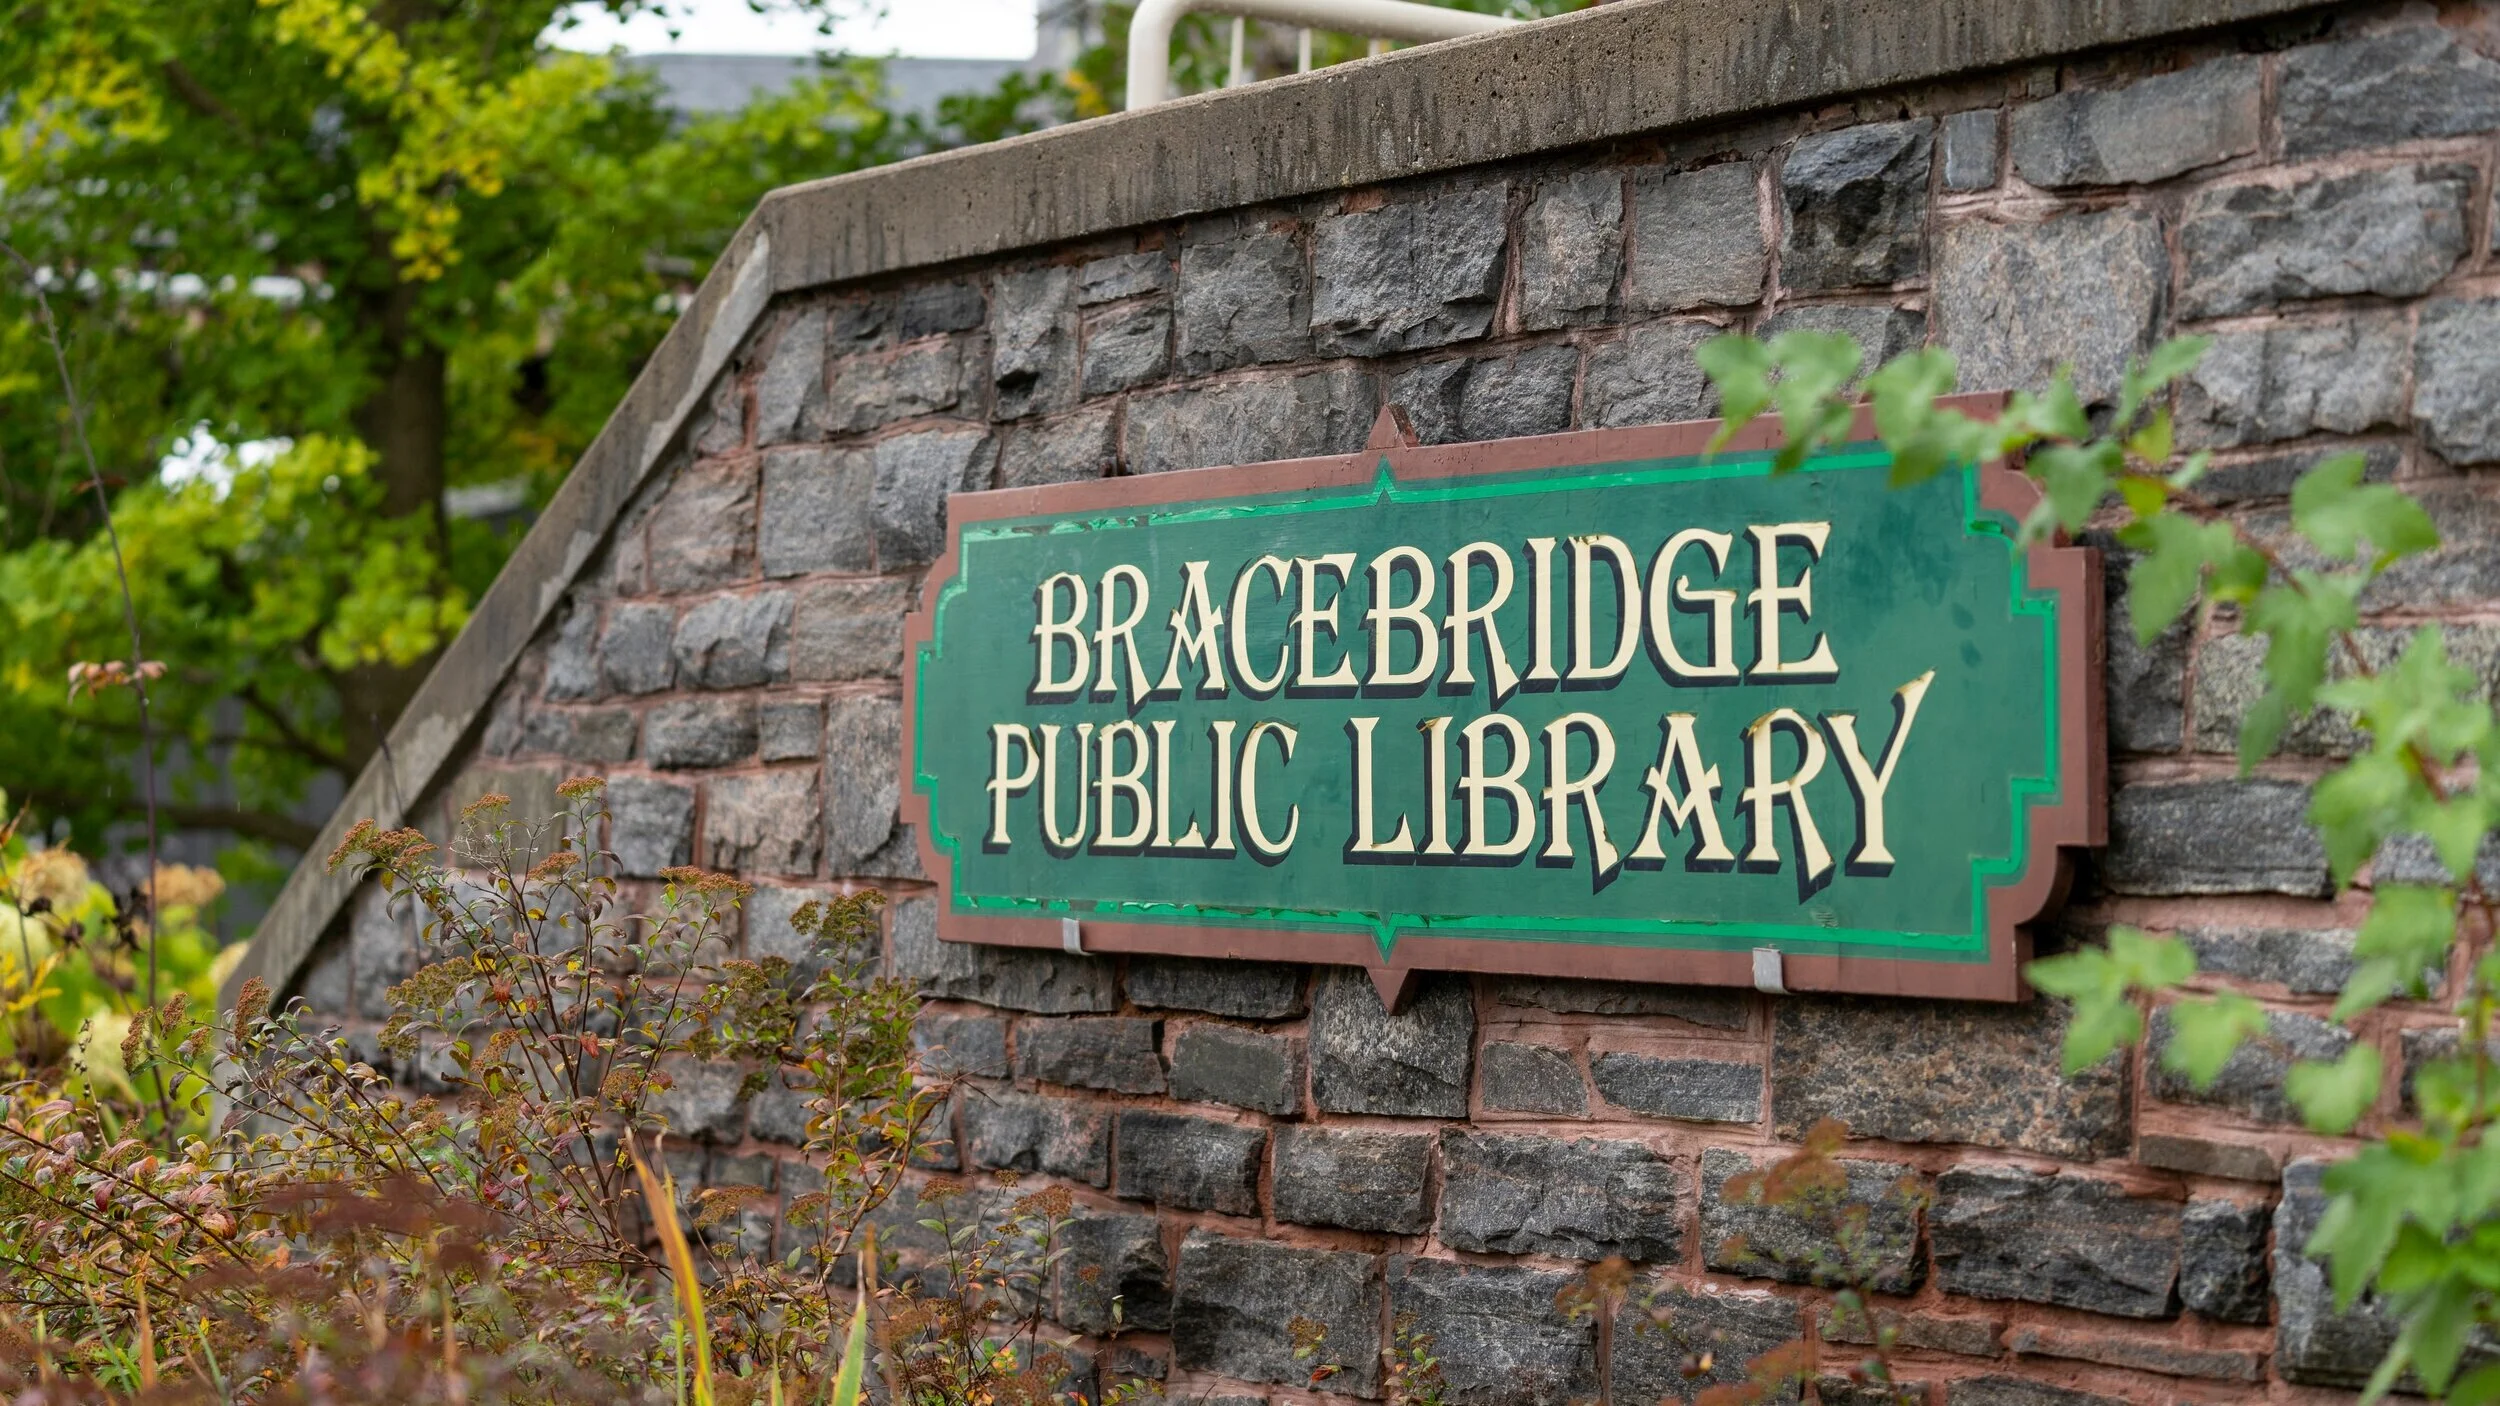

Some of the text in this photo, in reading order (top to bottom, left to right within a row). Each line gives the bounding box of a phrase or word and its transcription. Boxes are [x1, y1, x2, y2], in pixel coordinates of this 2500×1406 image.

[1029, 521, 1840, 707] BRACEBRIDGE
[985, 670, 1936, 886] PUBLIC LIBRARY
